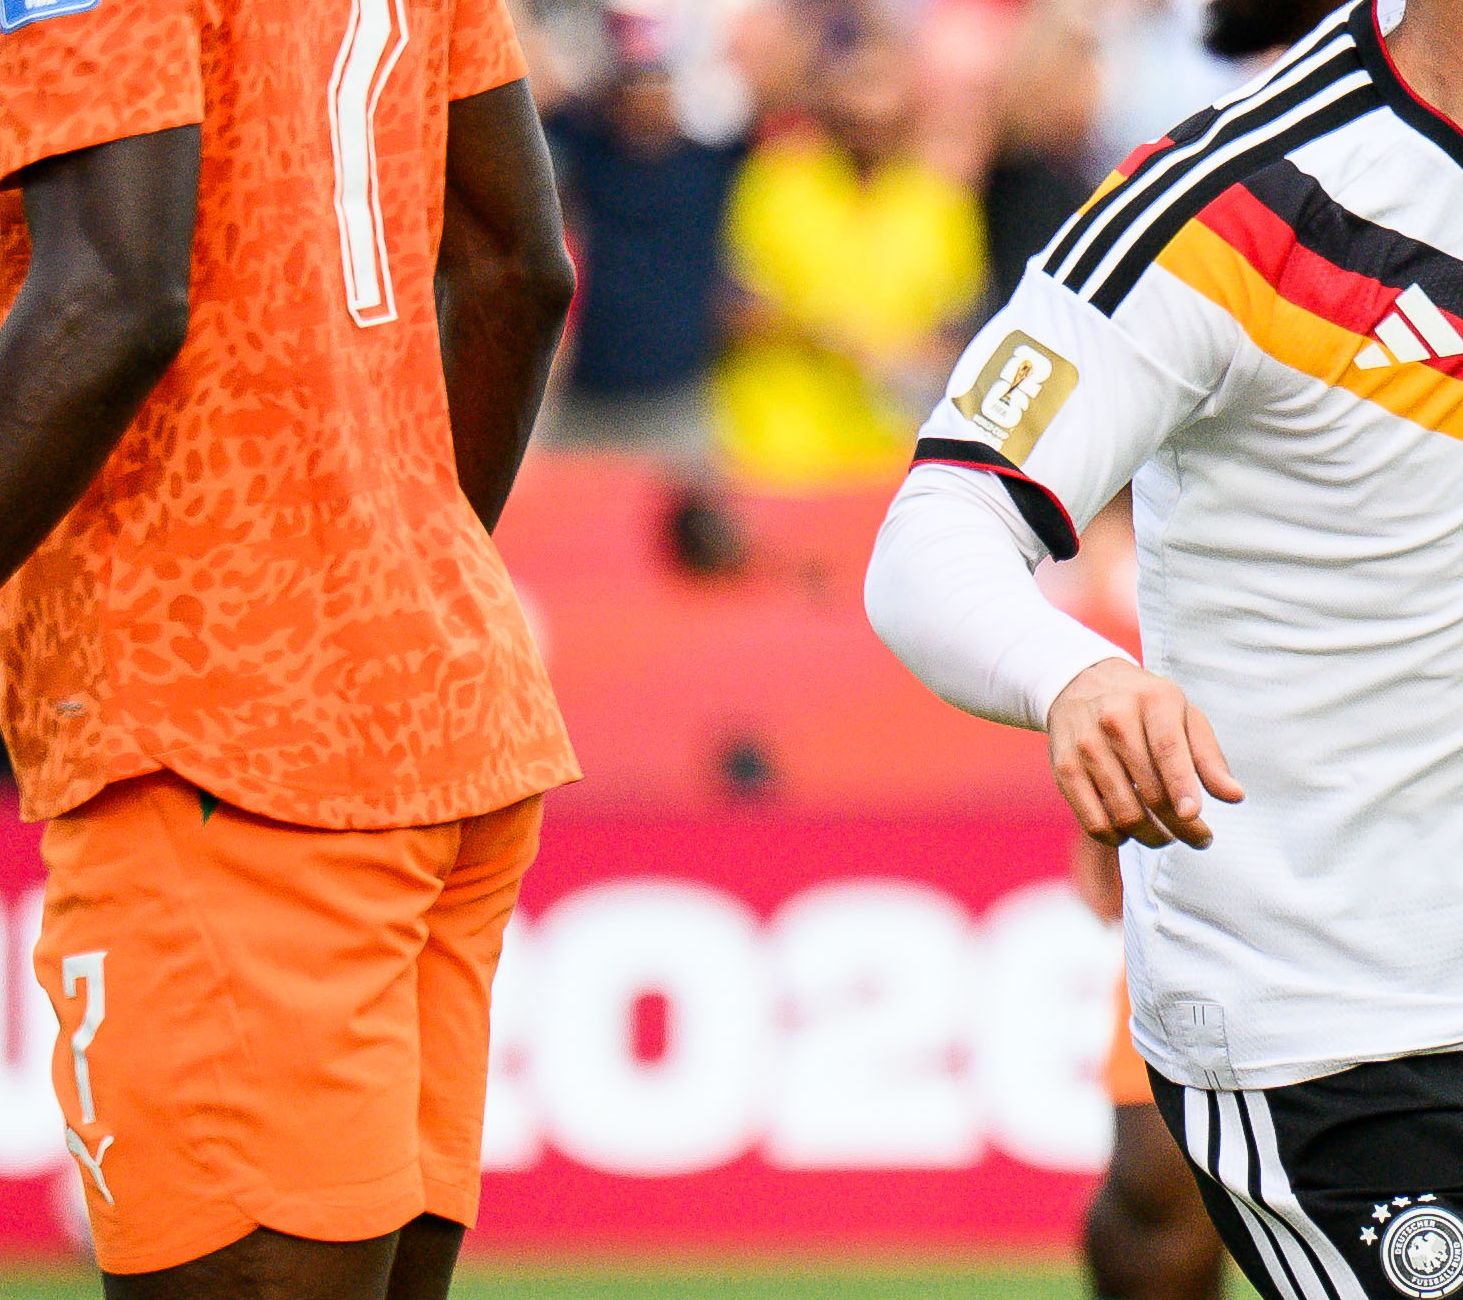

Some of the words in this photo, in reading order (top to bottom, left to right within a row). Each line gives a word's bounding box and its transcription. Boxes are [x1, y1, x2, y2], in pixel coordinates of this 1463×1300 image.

[62, 950, 109, 1124] 7
[480, 877, 1124, 1175] 026
[1394, 1220, 1436, 1255] DEUTSCHER
